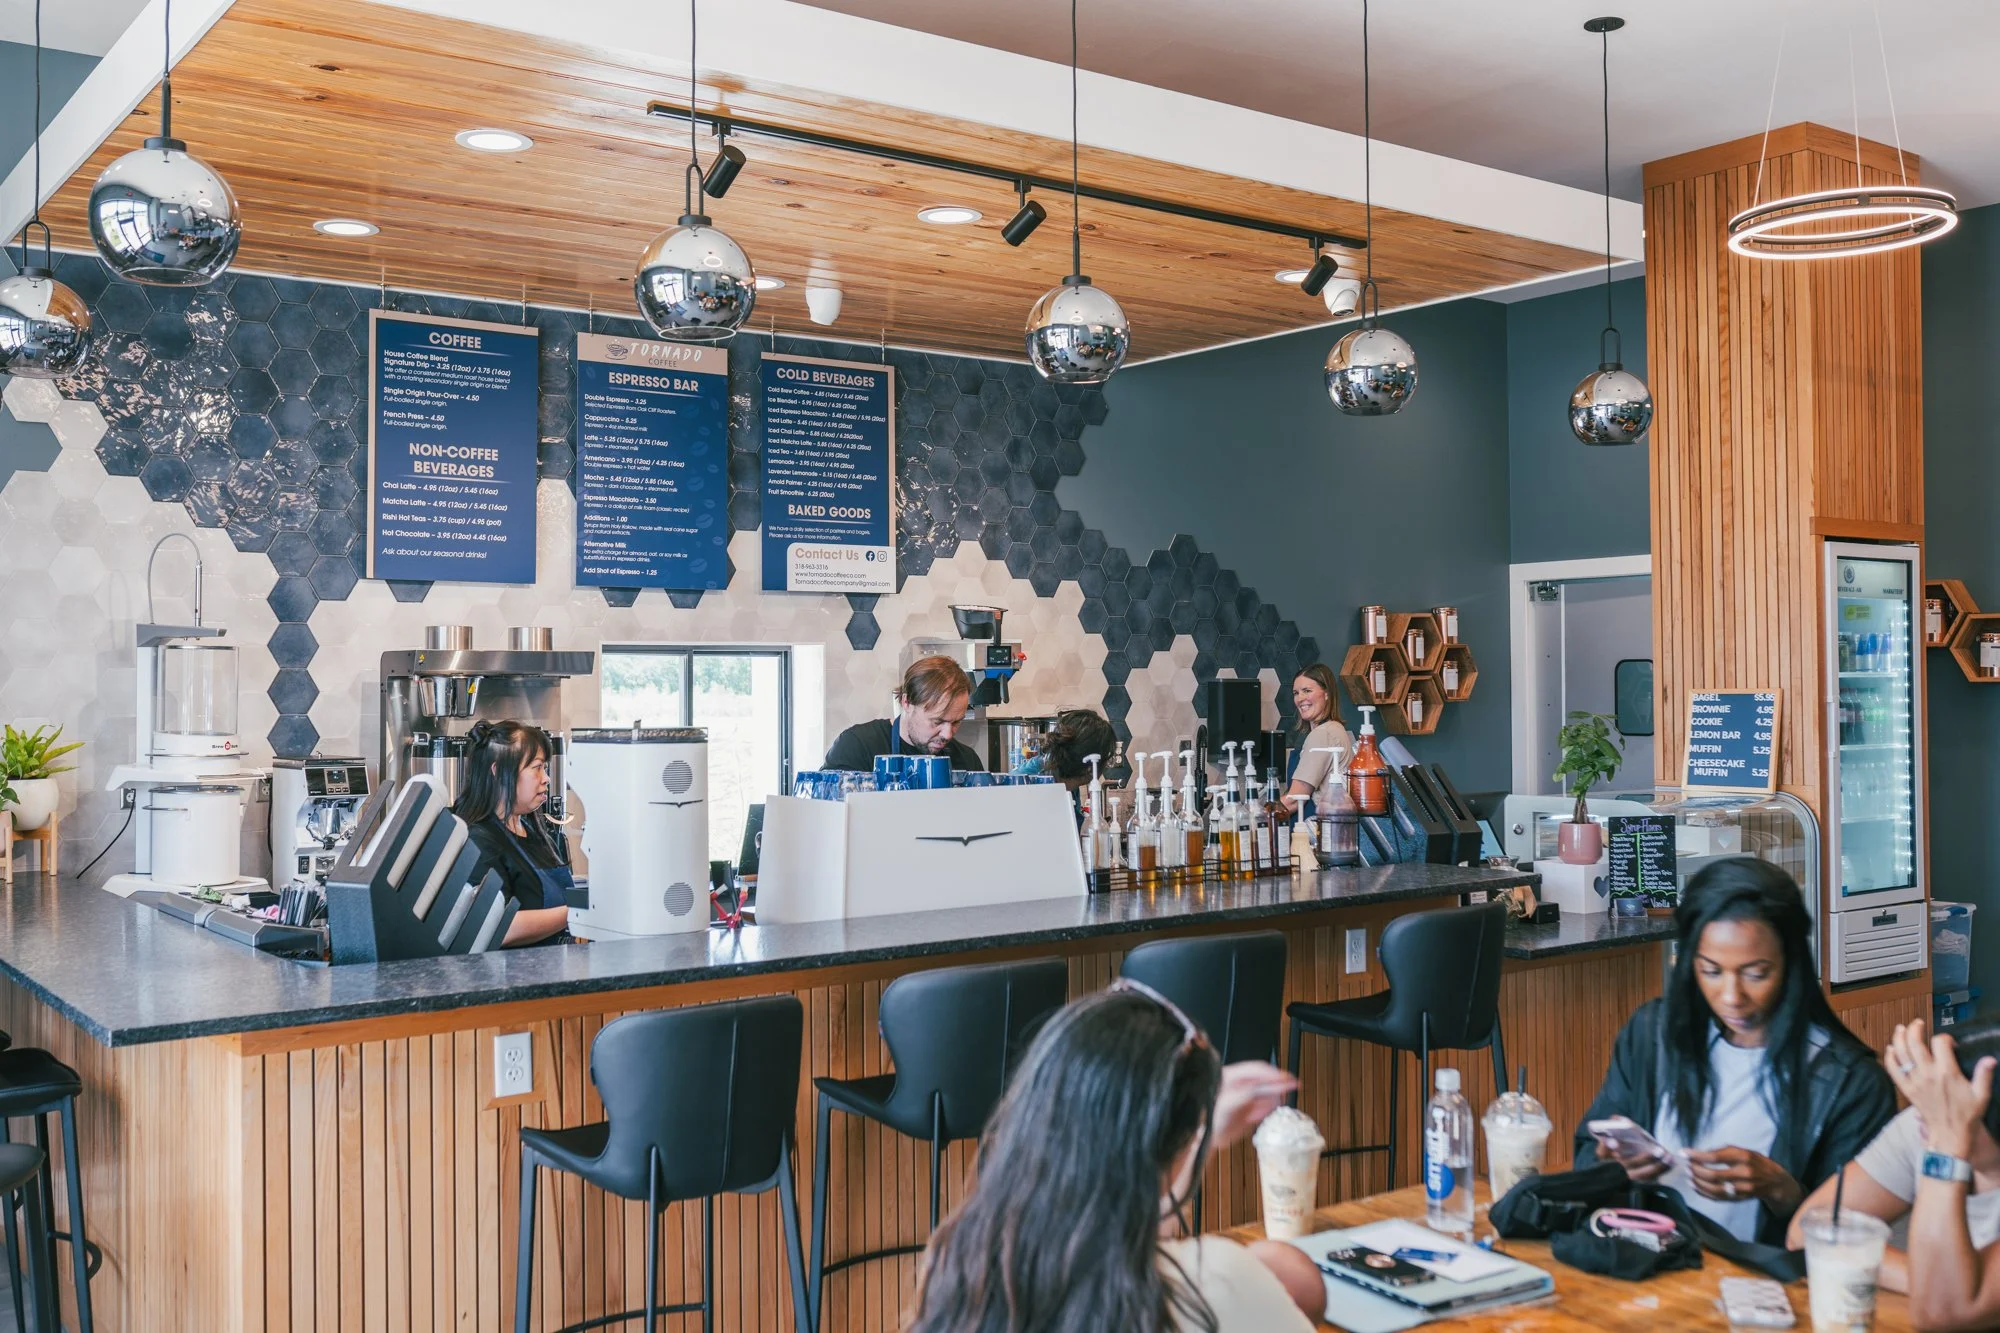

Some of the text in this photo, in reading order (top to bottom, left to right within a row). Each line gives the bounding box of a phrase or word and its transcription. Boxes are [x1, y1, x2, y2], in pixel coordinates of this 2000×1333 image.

[429, 332, 481, 349] COFFEE
[630, 342, 702, 361] TORNADO
[384, 358, 415, 367] Signature
[648, 358, 677, 367] COFFEE
[609, 372, 698, 392] ESPRESSO BAR
[777, 368, 874, 387] COLD BEVERAGES
[384, 387, 404, 396] Single
[406, 389, 425, 398] Origin
[427, 391, 459, 400] Pour-Over
[585, 414, 619, 423] Cappuccino
[410, 443, 498, 461] NON-COFFEE
[414, 461, 494, 477] BEVERAGES
[788, 504, 871, 519] BAKED GOODS
[795, 548, 859, 560] Contact Us
[1692, 705, 1731, 713] BROWNIE
[1755, 718, 1773, 726] 4.25
[1754, 732, 1771, 740] 4.95
[1689, 745, 1770, 754] MUFFIN 5.25
[1688, 759, 1745, 768] CHEESECAKE
[1694, 768, 1768, 777] MUFFIN 5.25
